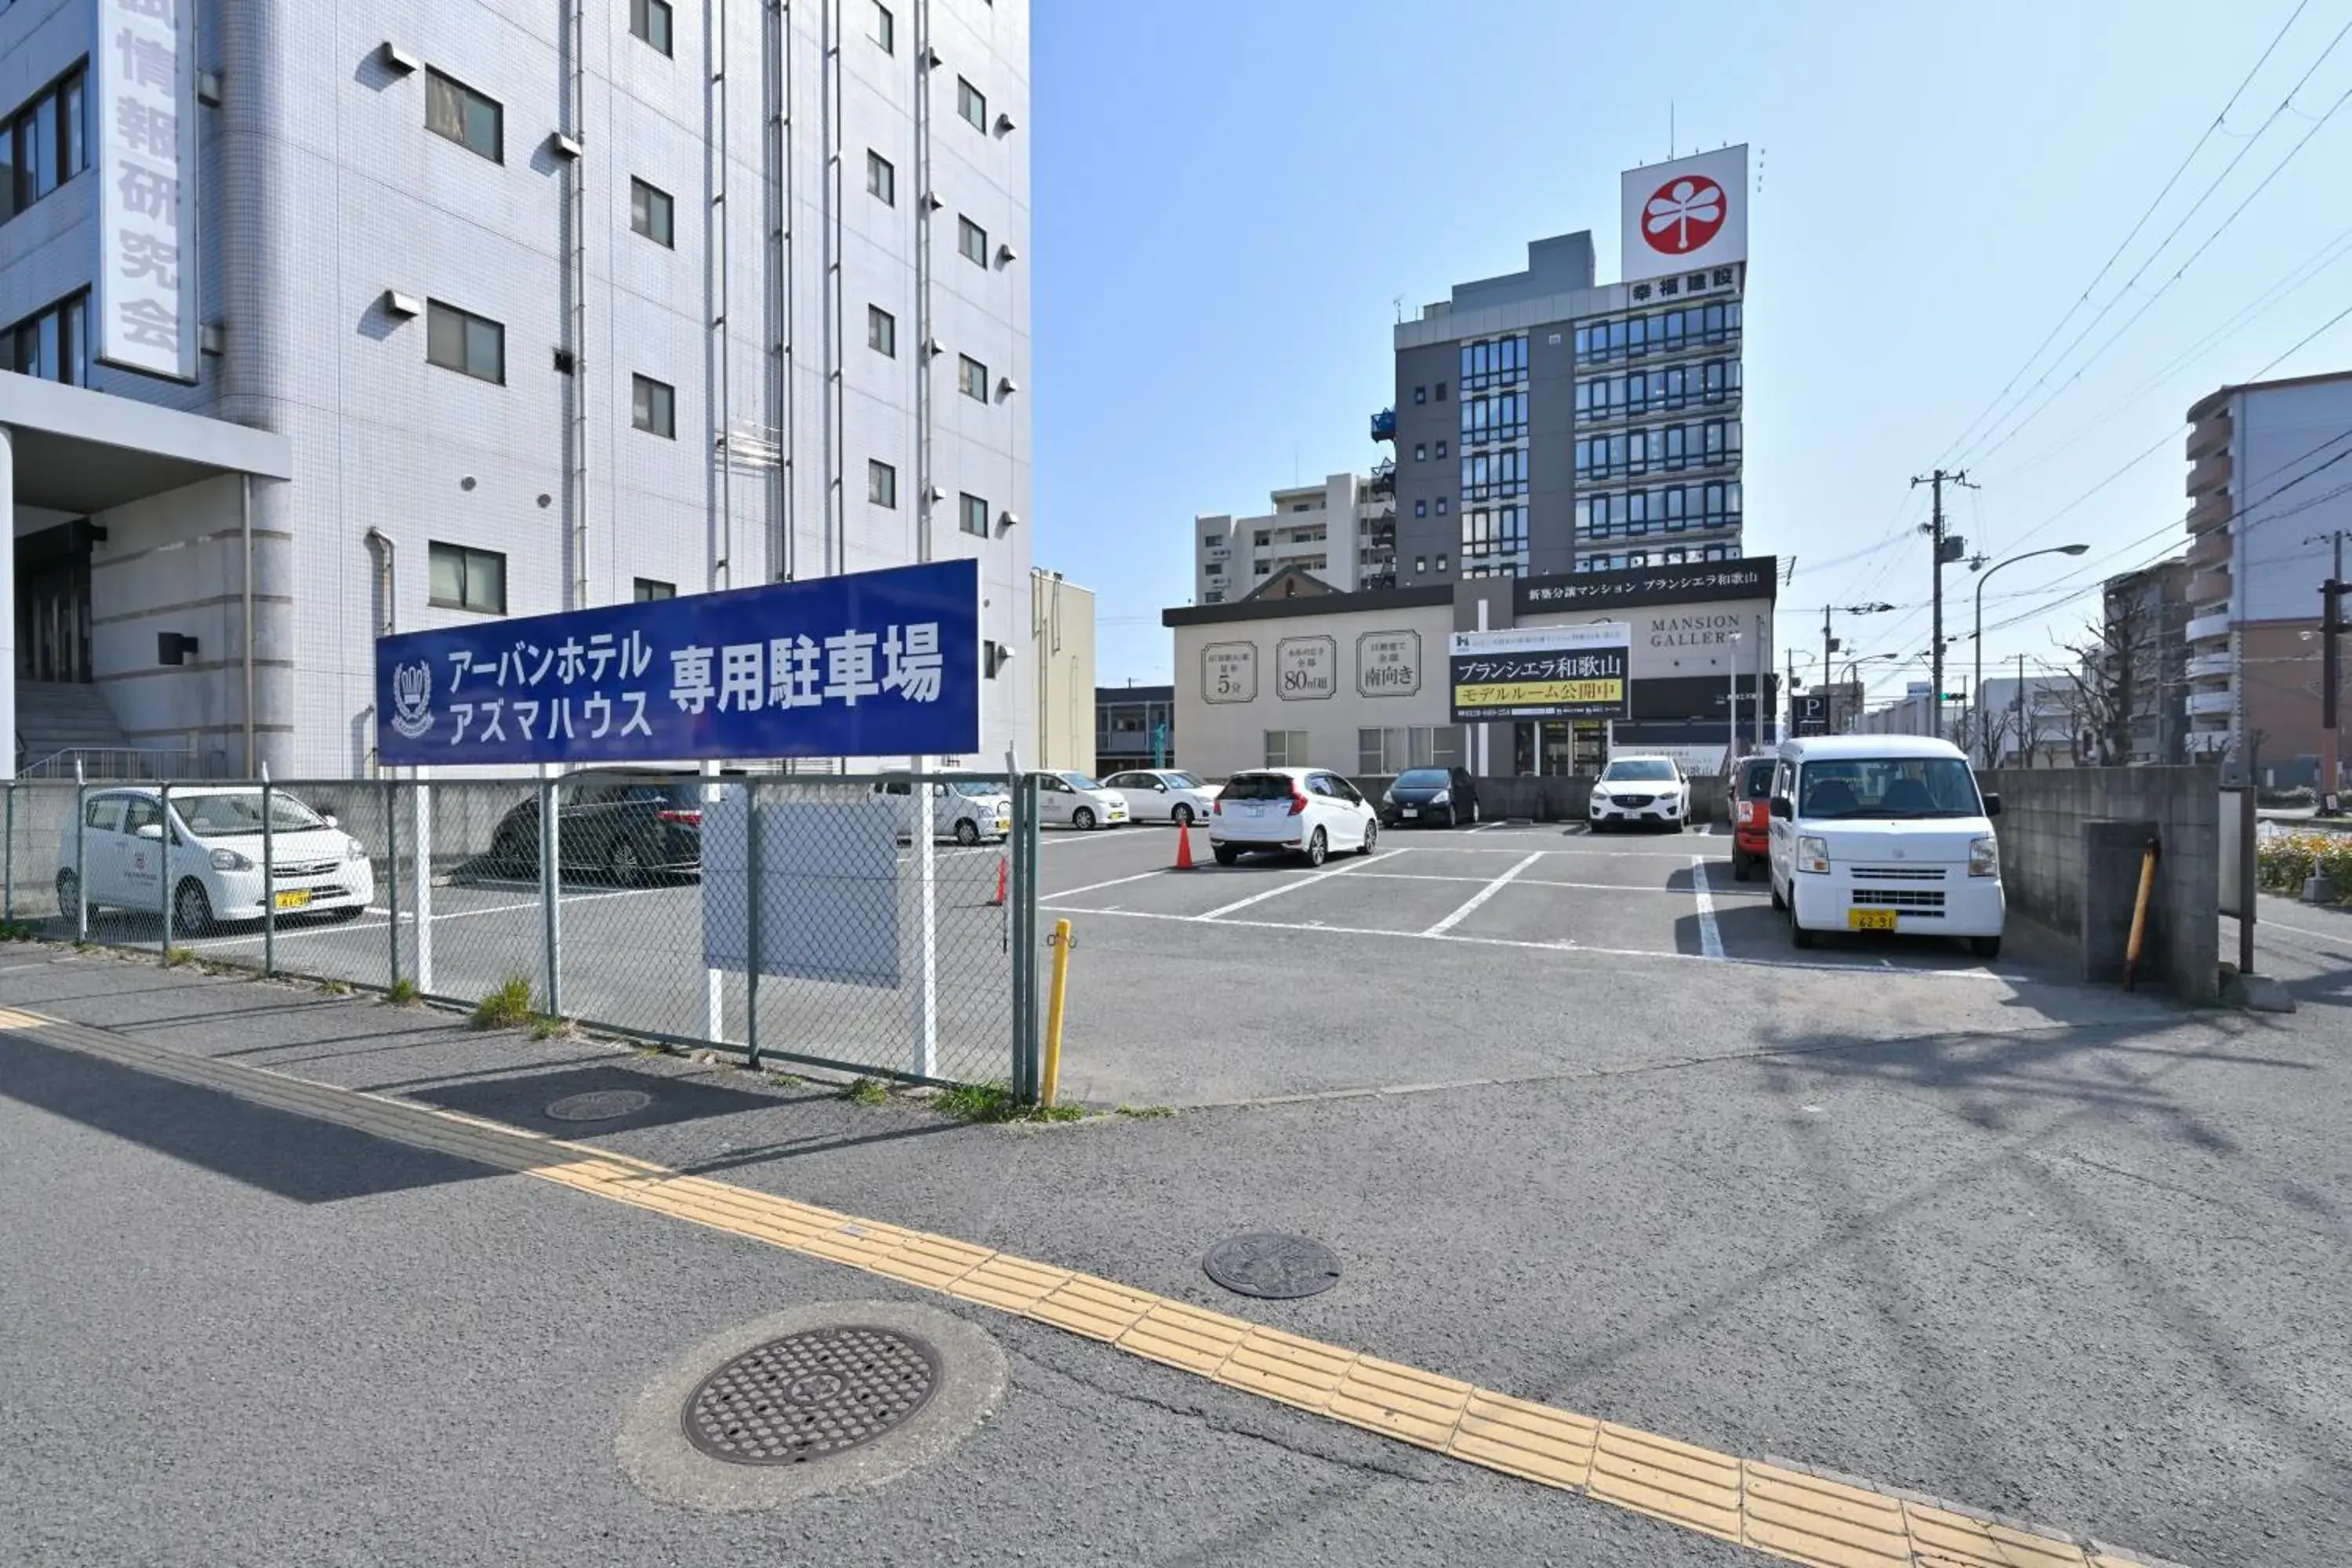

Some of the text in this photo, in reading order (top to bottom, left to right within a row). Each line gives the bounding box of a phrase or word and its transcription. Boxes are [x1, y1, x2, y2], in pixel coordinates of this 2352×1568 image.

[116, 0, 180, 352] 情報研究会
[1632, 267, 1733, 301] 幸福建設
[1644, 572, 1758, 591] ブランシエラ和歌山
[1651, 615, 1740, 632] MANSION
[448, 630, 652, 694] アーバンホテル
[670, 622, 942, 714] 専用駐車場
[1458, 655, 1621, 681] ブランシエラ和歌山
[1365, 665, 1413, 688] 南向き
[1462, 683, 1615, 702] モデルルーム公開中
[449, 691, 652, 745] アズマハウス
[1806, 699, 1820, 716] P
